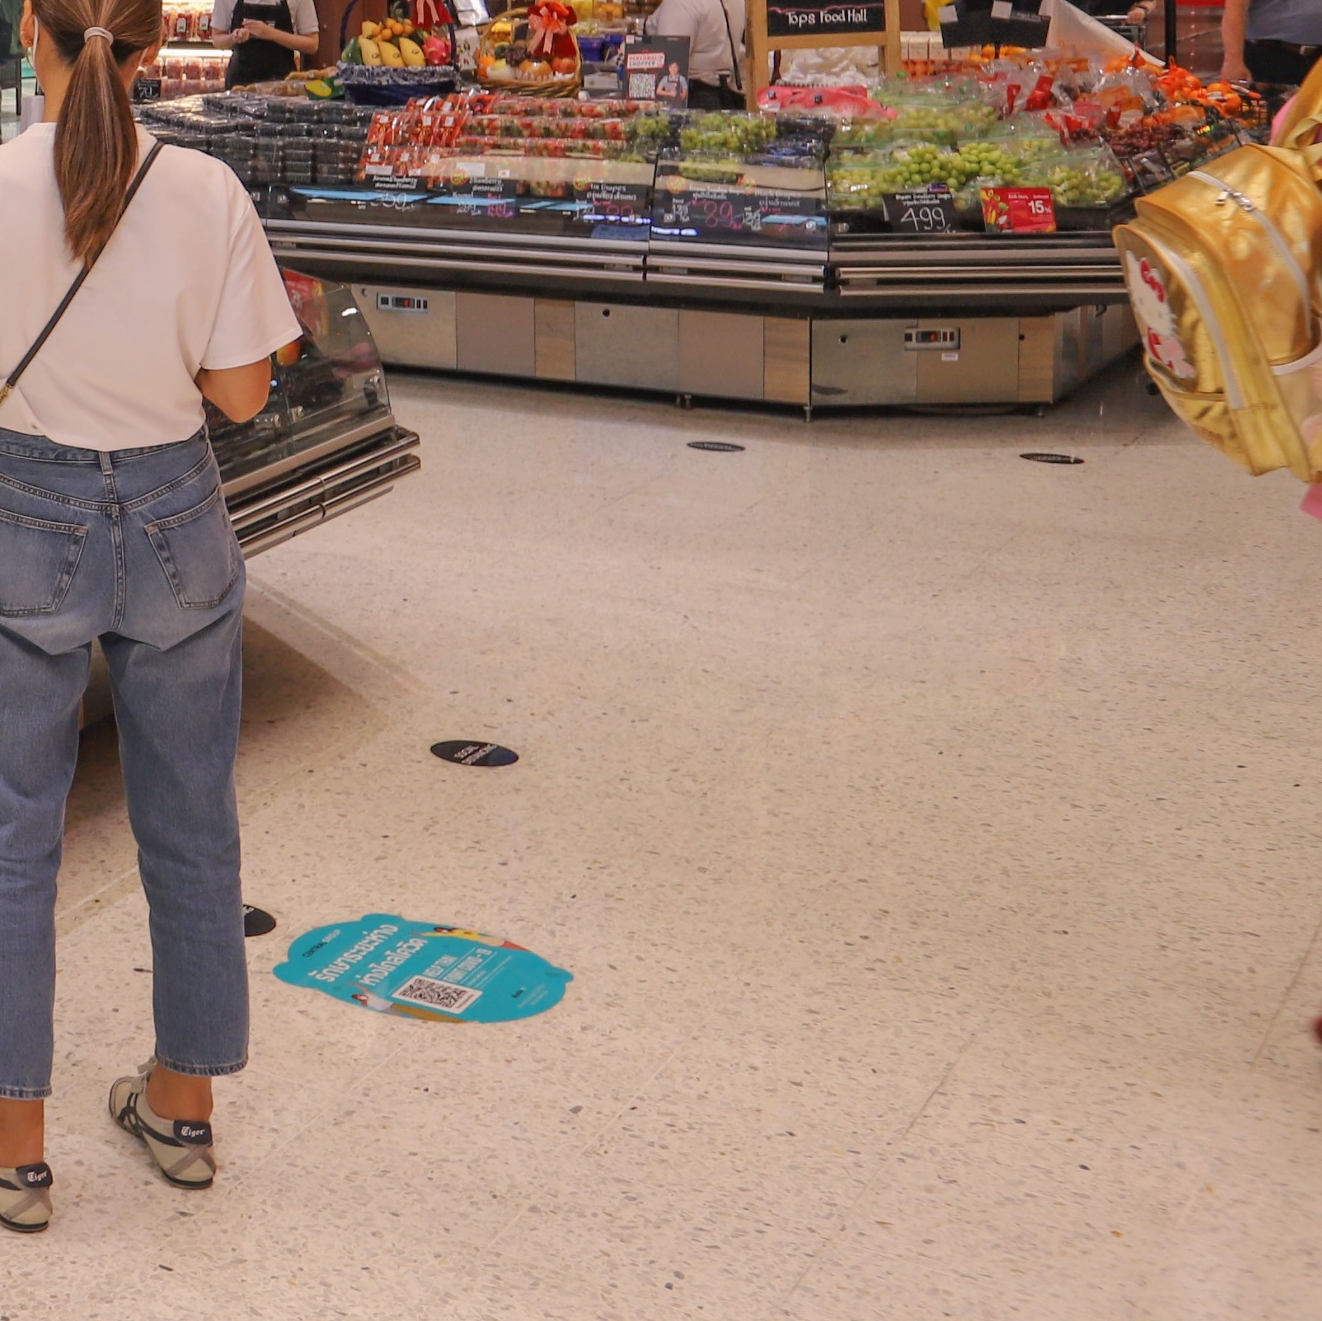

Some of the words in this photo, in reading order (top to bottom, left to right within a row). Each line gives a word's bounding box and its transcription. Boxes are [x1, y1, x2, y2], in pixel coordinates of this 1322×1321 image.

[785, 10, 815, 28] Tops
[820, 9, 846, 24] Food
[847, 9, 868, 23] Hall
[901, 206, 947, 231] 499
